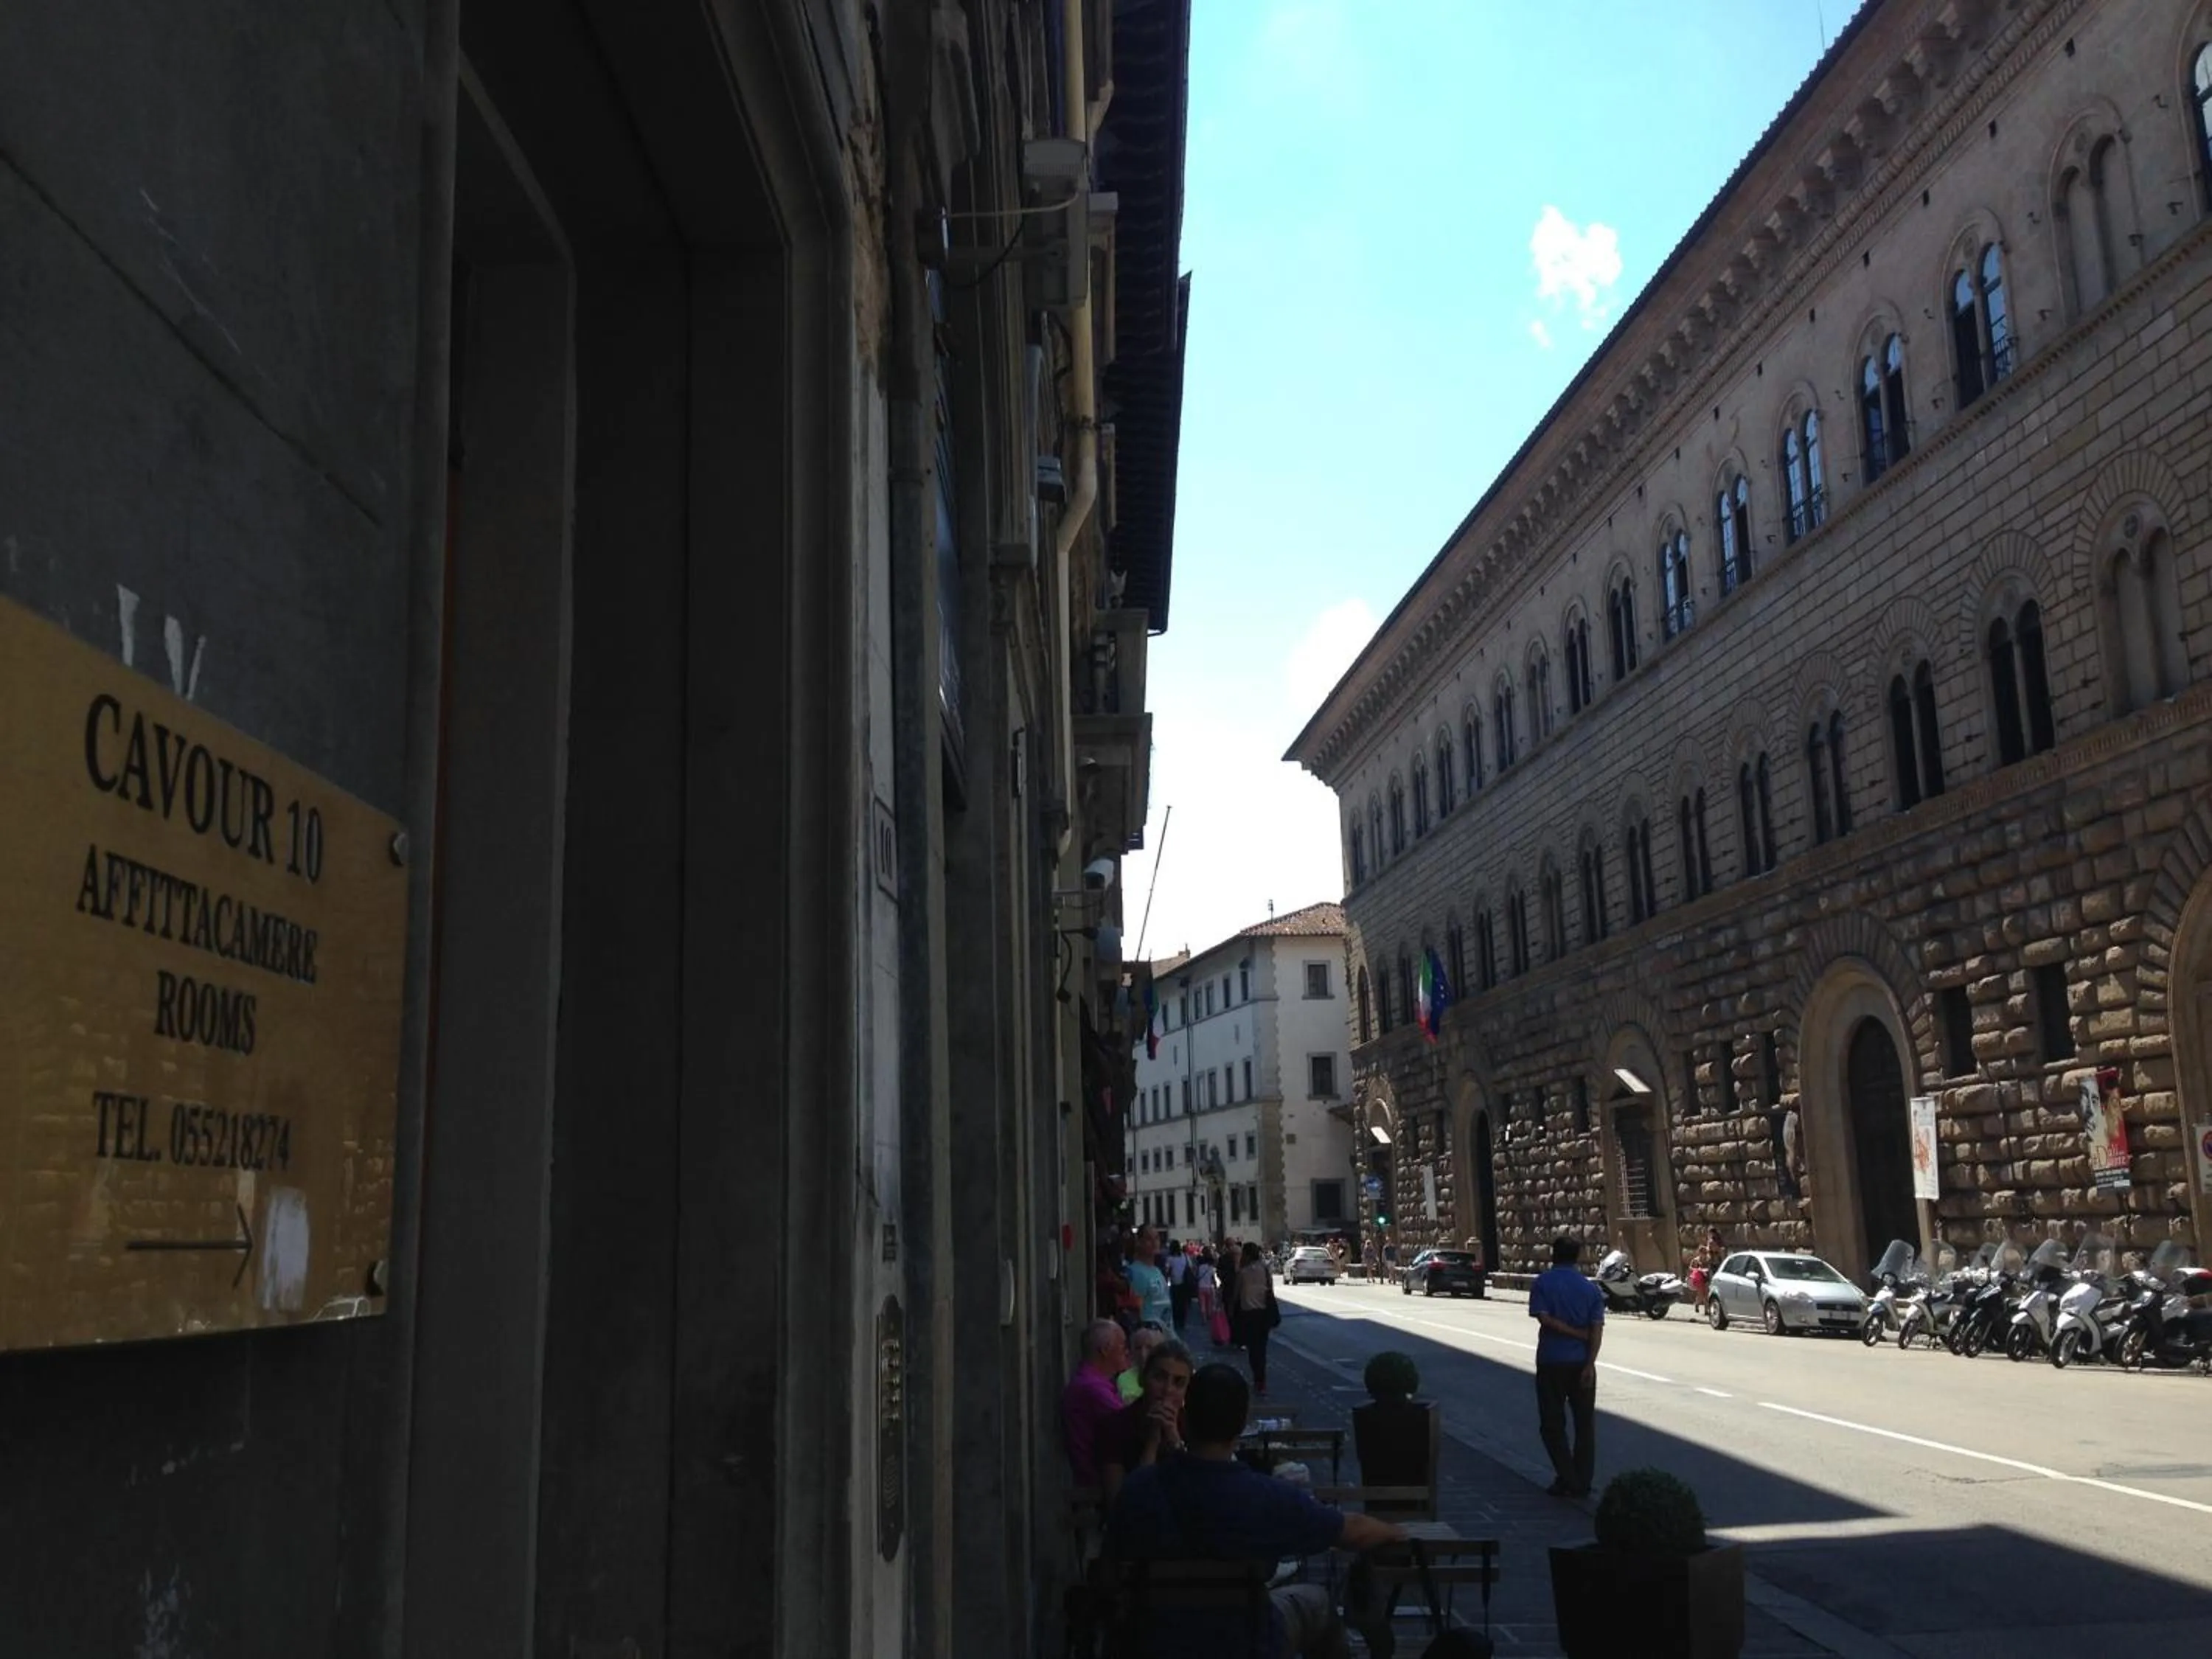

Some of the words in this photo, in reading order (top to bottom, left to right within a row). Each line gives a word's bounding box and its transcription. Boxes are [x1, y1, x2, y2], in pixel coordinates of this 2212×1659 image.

[85, 693, 275, 865] CAVOUR
[287, 799, 323, 884] 10
[76, 843, 318, 984] AFFITTACAMERE
[153, 969, 257, 1056] ROOMS
[93, 1091, 161, 1161] TEL.
[170, 1103, 291, 1171] 055218274
